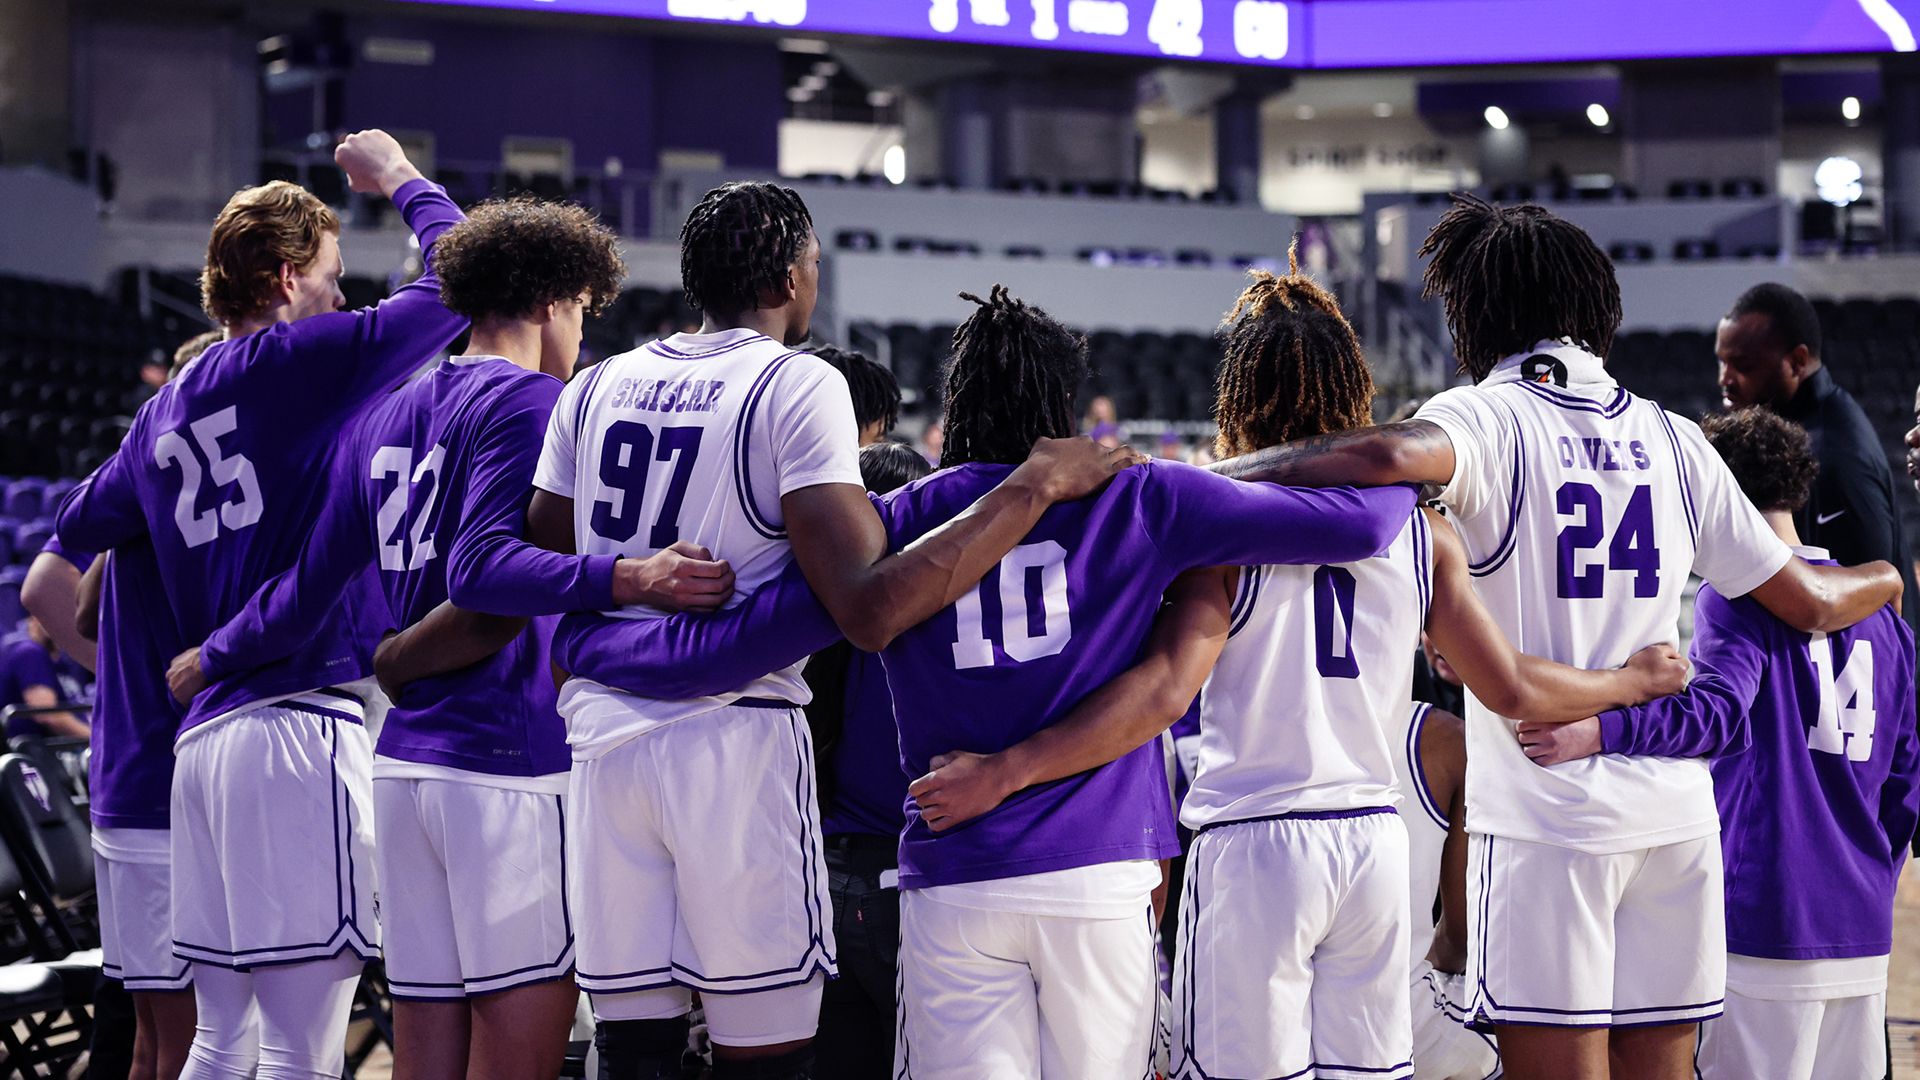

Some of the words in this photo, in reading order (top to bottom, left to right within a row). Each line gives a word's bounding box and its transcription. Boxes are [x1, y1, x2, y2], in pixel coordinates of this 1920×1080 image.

[154, 404, 264, 548] 25
[371, 443, 447, 571] 22
[590, 420, 704, 549] 97
[1556, 436, 1651, 471] OWENS
[1556, 482, 1660, 599] 24
[952, 540, 1072, 670] 10
[1314, 564, 1360, 679] 0
[1808, 630, 1876, 761] 14
